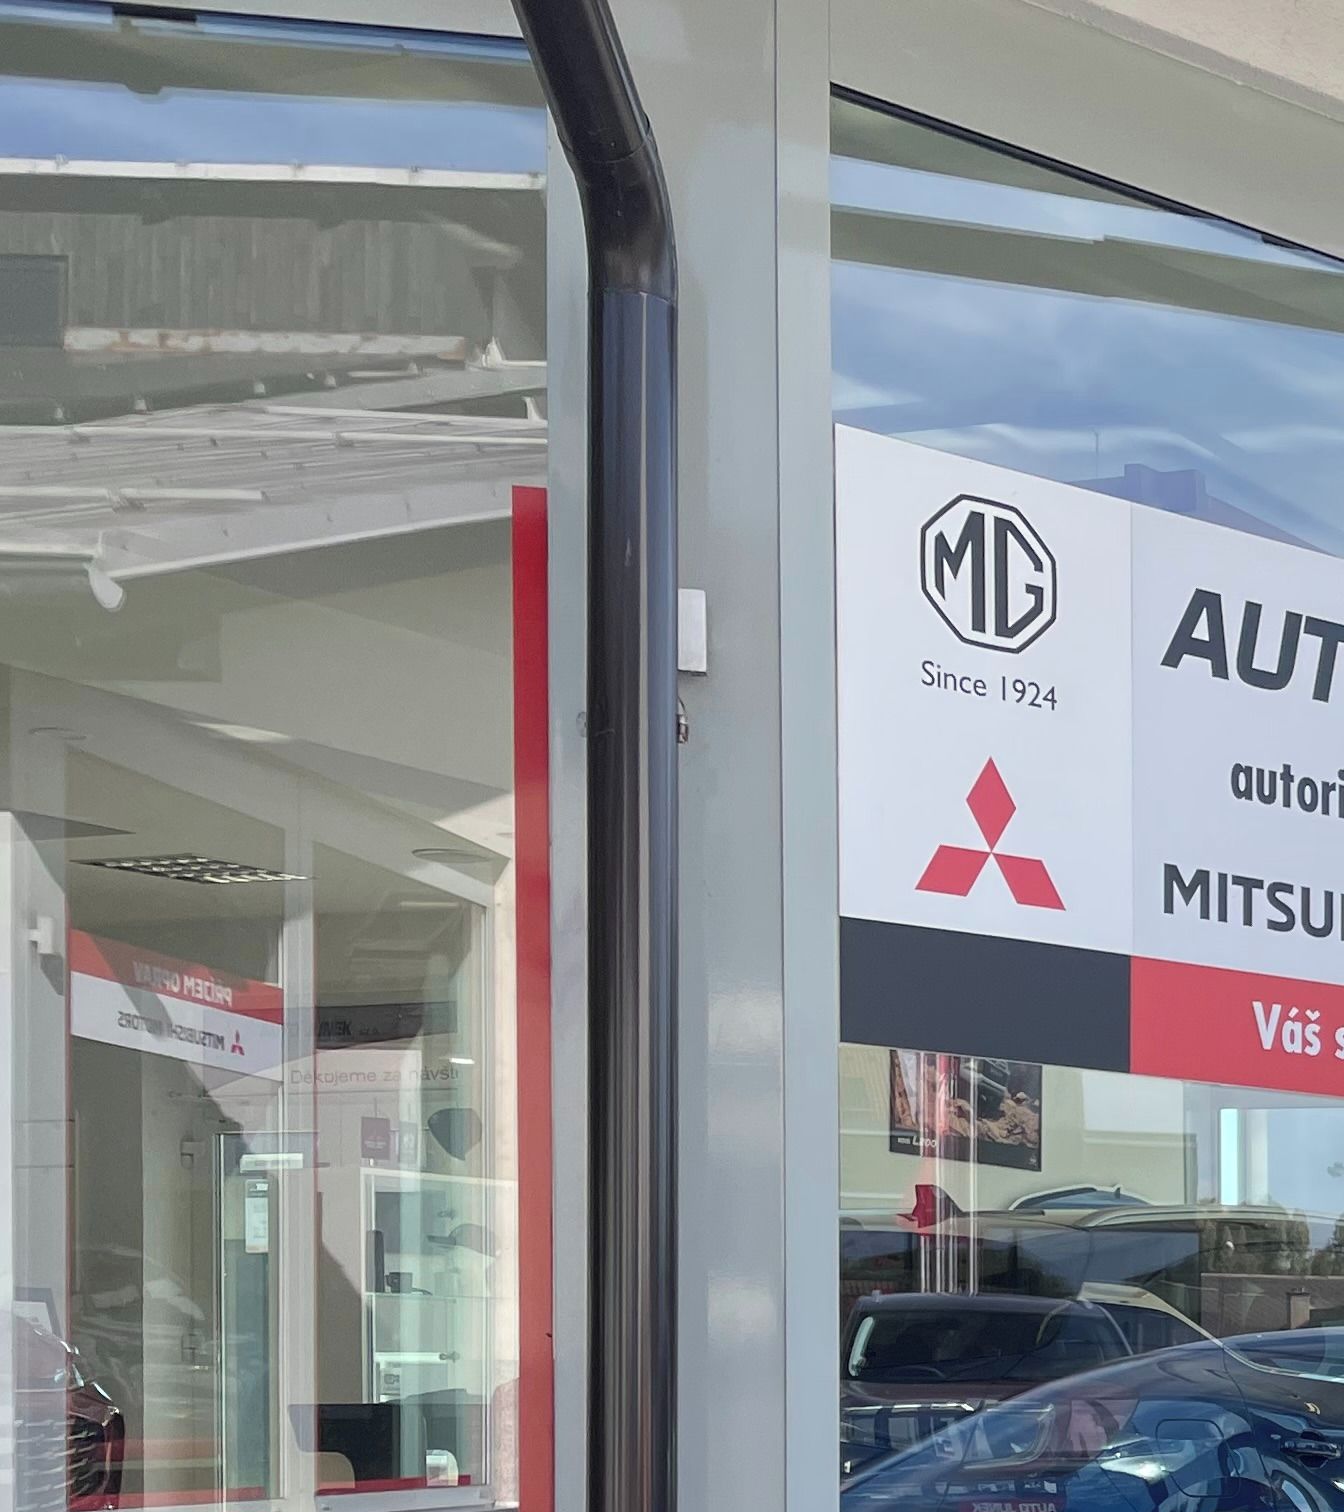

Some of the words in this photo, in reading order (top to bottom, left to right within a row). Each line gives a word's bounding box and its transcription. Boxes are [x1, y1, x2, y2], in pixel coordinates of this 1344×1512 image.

[934, 511, 1046, 639] MG
[921, 660, 987, 698] Since
[1000, 678, 1058, 712] 1924
[1253, 1001, 1321, 1055] Váš
